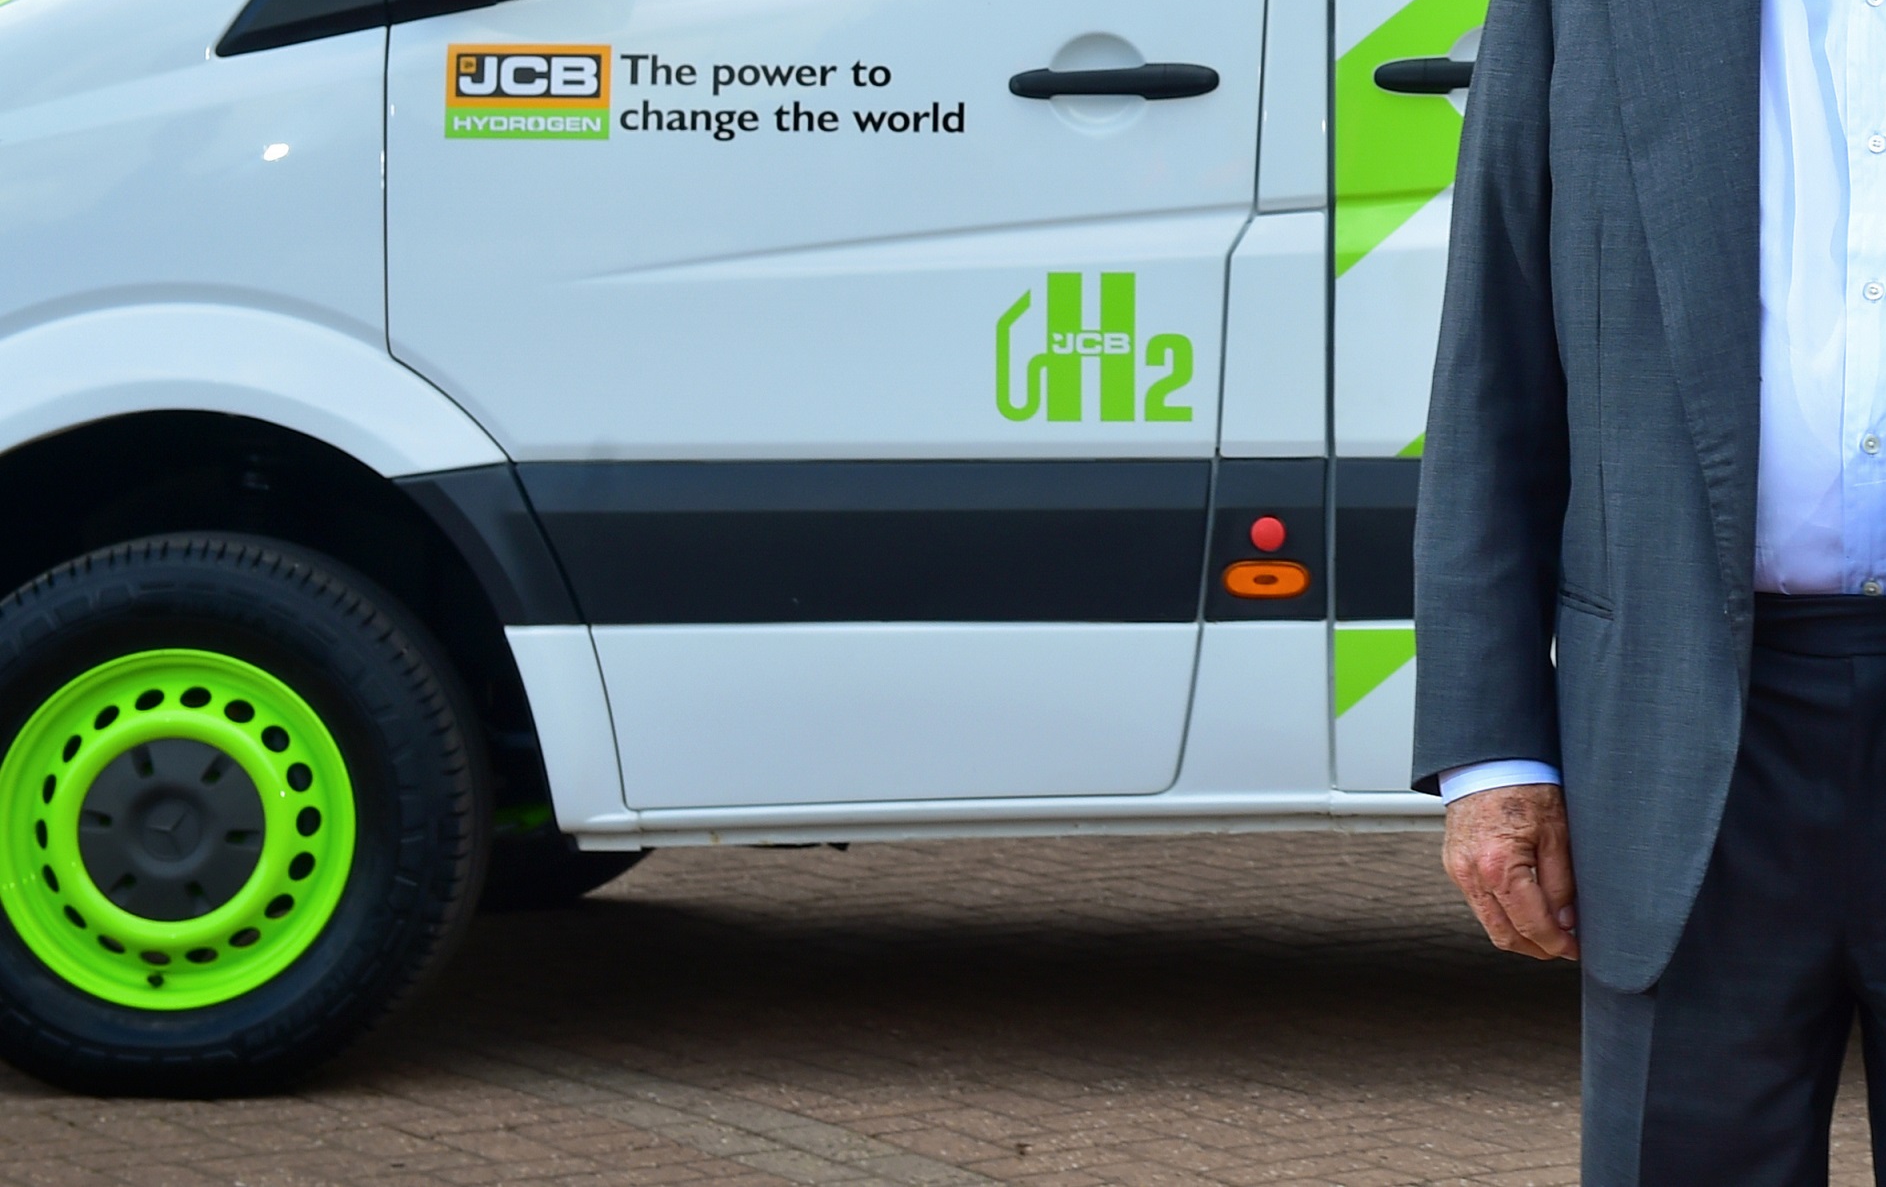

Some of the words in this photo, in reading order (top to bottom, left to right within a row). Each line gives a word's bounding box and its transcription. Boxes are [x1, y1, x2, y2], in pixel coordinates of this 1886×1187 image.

[459, 55, 599, 96] JCB
[620, 54, 697, 86] The
[712, 63, 837, 96] power
[851, 60, 892, 87] to
[453, 115, 601, 132] HYDROGEN
[619, 100, 759, 142] change
[774, 101, 839, 132] the
[852, 102, 965, 133] world
[1052, 332, 1131, 355] JCB
